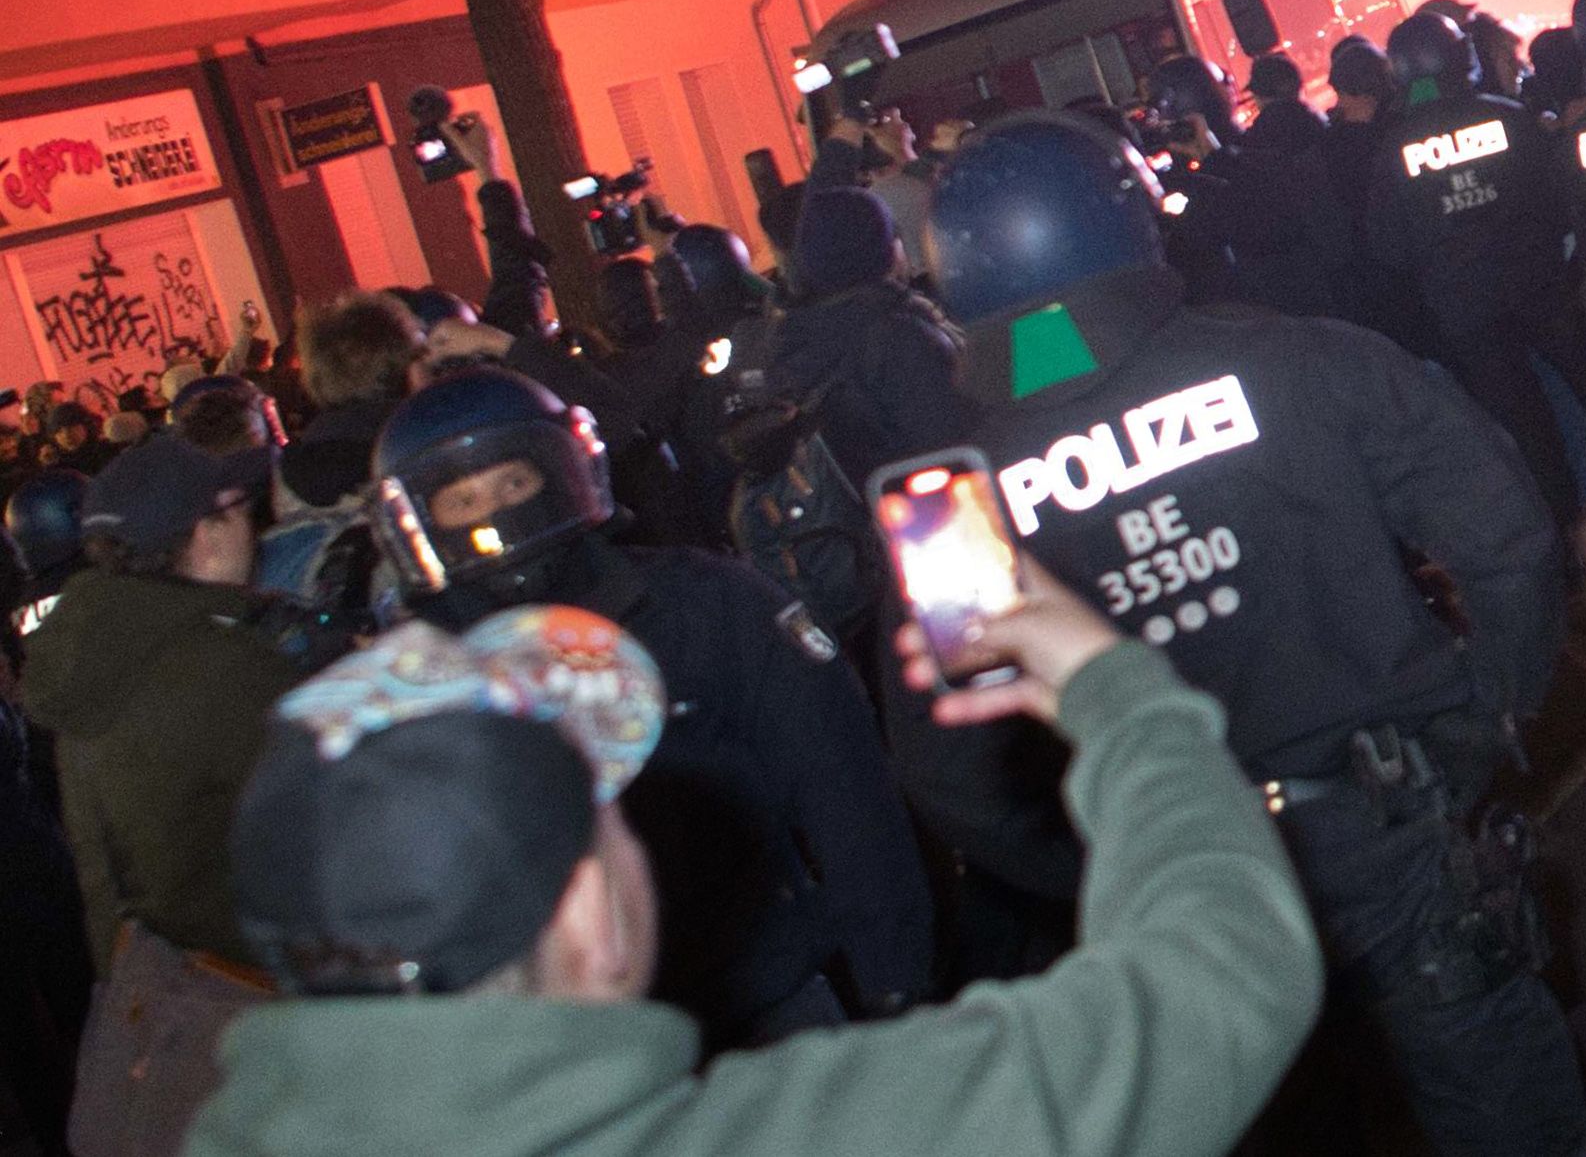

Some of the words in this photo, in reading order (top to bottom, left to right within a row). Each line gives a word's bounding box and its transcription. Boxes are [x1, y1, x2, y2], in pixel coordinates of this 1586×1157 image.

[1402, 119, 1509, 177] POLIZEI
[1451, 169, 1479, 191] BE
[999, 374, 1260, 536] POLIZEI
[1117, 494, 1190, 555] BE
[1098, 526, 1241, 615] 35300
